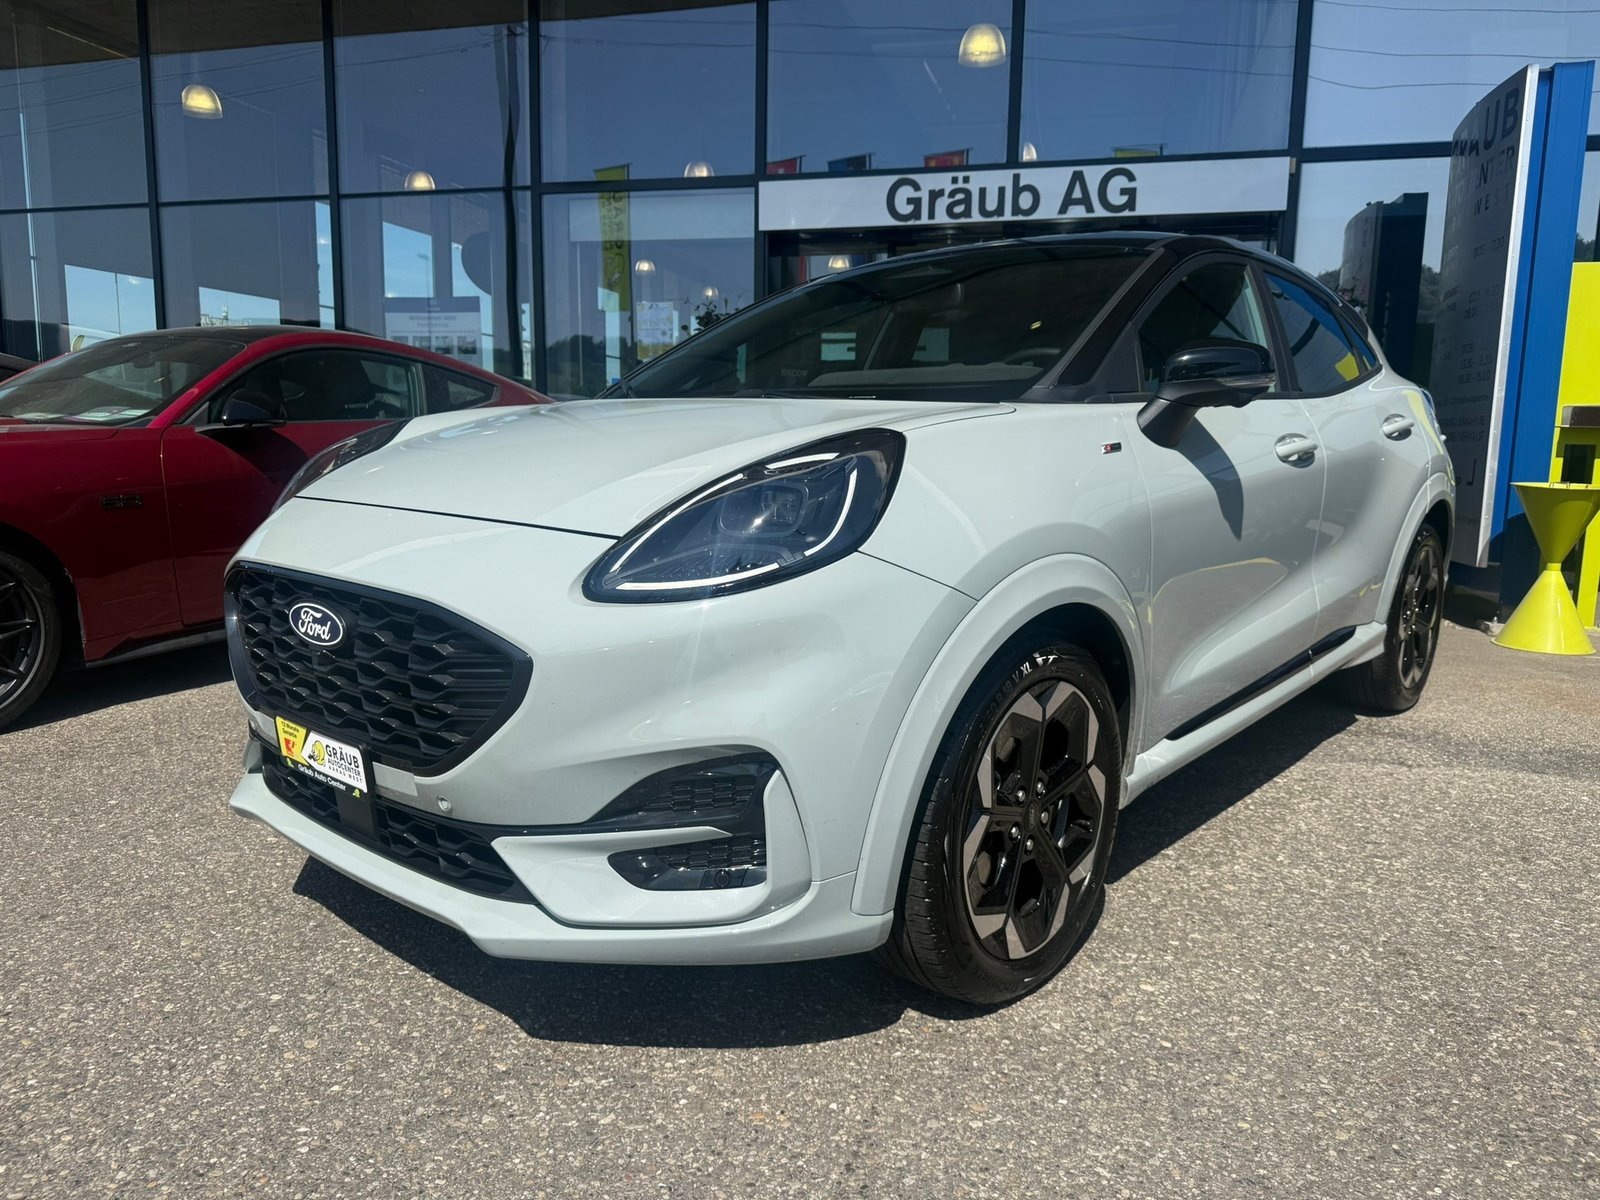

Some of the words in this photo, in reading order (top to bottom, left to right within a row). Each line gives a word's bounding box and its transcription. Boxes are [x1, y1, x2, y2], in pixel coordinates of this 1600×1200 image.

[886, 173, 1041, 225] Gräub
[1058, 167, 1138, 216] AG
[298, 607, 332, 641] Ford
[1020, 661, 1033, 678] XL
[325, 745, 359, 768] GRÄUB
[327, 757, 361, 778] AUTOCENTER
